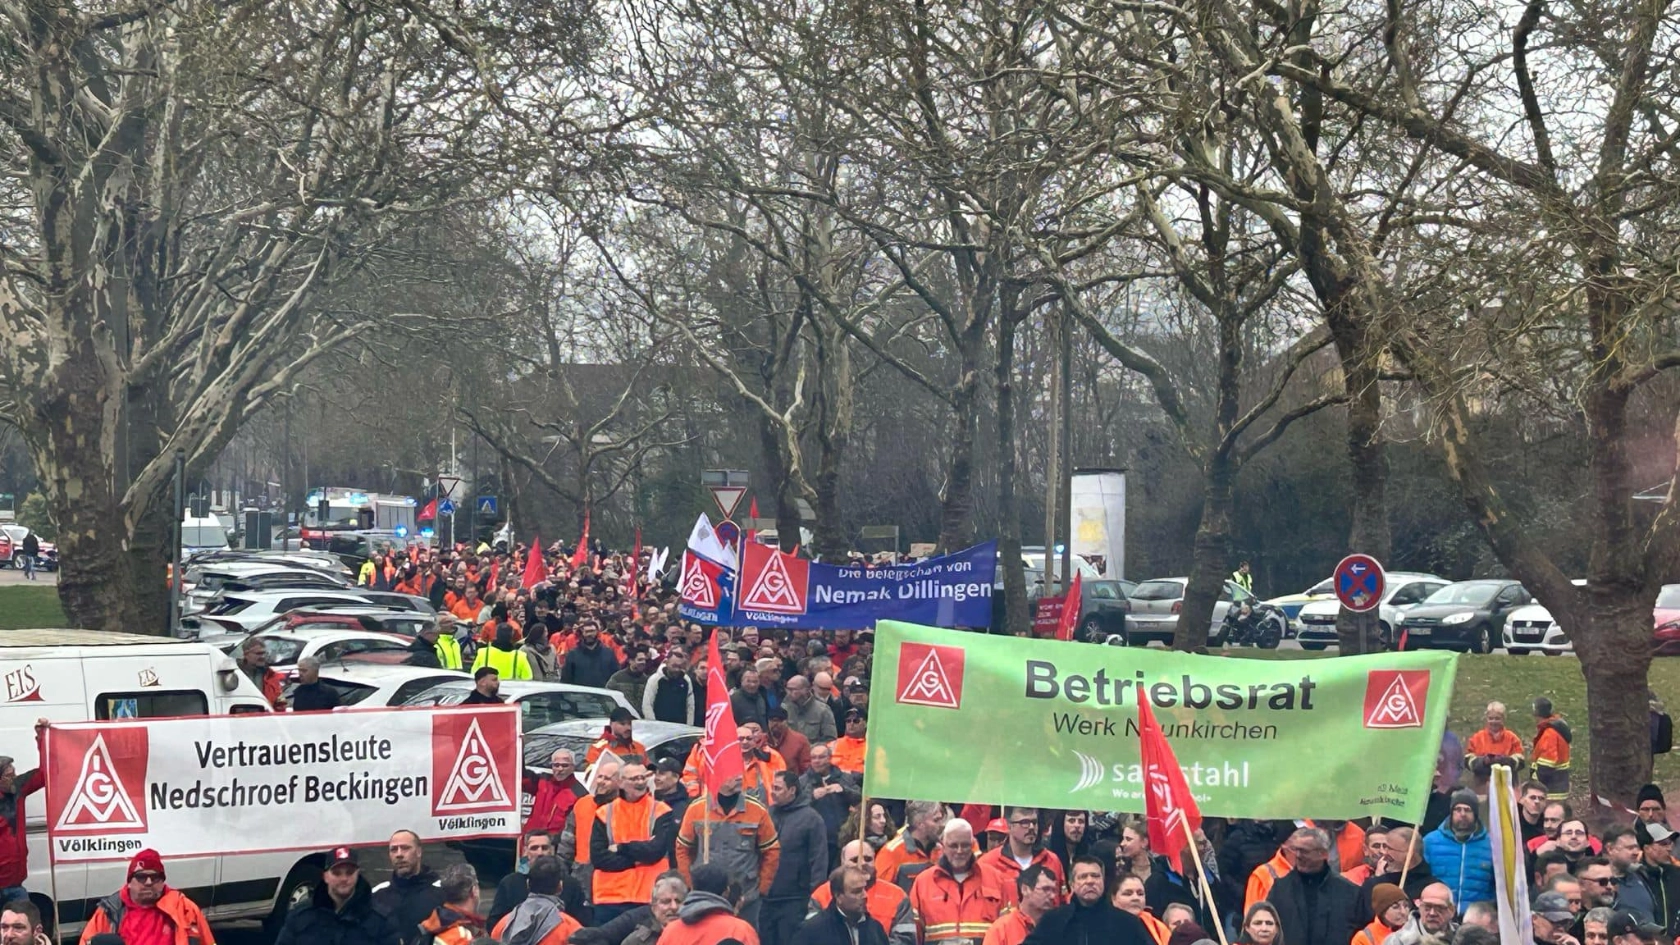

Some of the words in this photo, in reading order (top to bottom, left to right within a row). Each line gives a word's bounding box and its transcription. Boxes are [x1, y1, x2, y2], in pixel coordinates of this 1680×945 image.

[947, 561, 972, 573] von
[815, 585, 891, 604] Nemak
[899, 579, 992, 602] Dillingen
[5, 664, 37, 701] EIS
[1025, 659, 1317, 711] Betriebsrat
[1053, 712, 1117, 736] Werk
[1124, 717, 1278, 741] Nunkirchen
[195, 734, 392, 769] Vertrauensleute
[151, 775, 299, 811] Nedschroef
[304, 771, 428, 805] Beckingen
[439, 817, 506, 831] Völklingen
[59, 838, 143, 853] Völklingen
